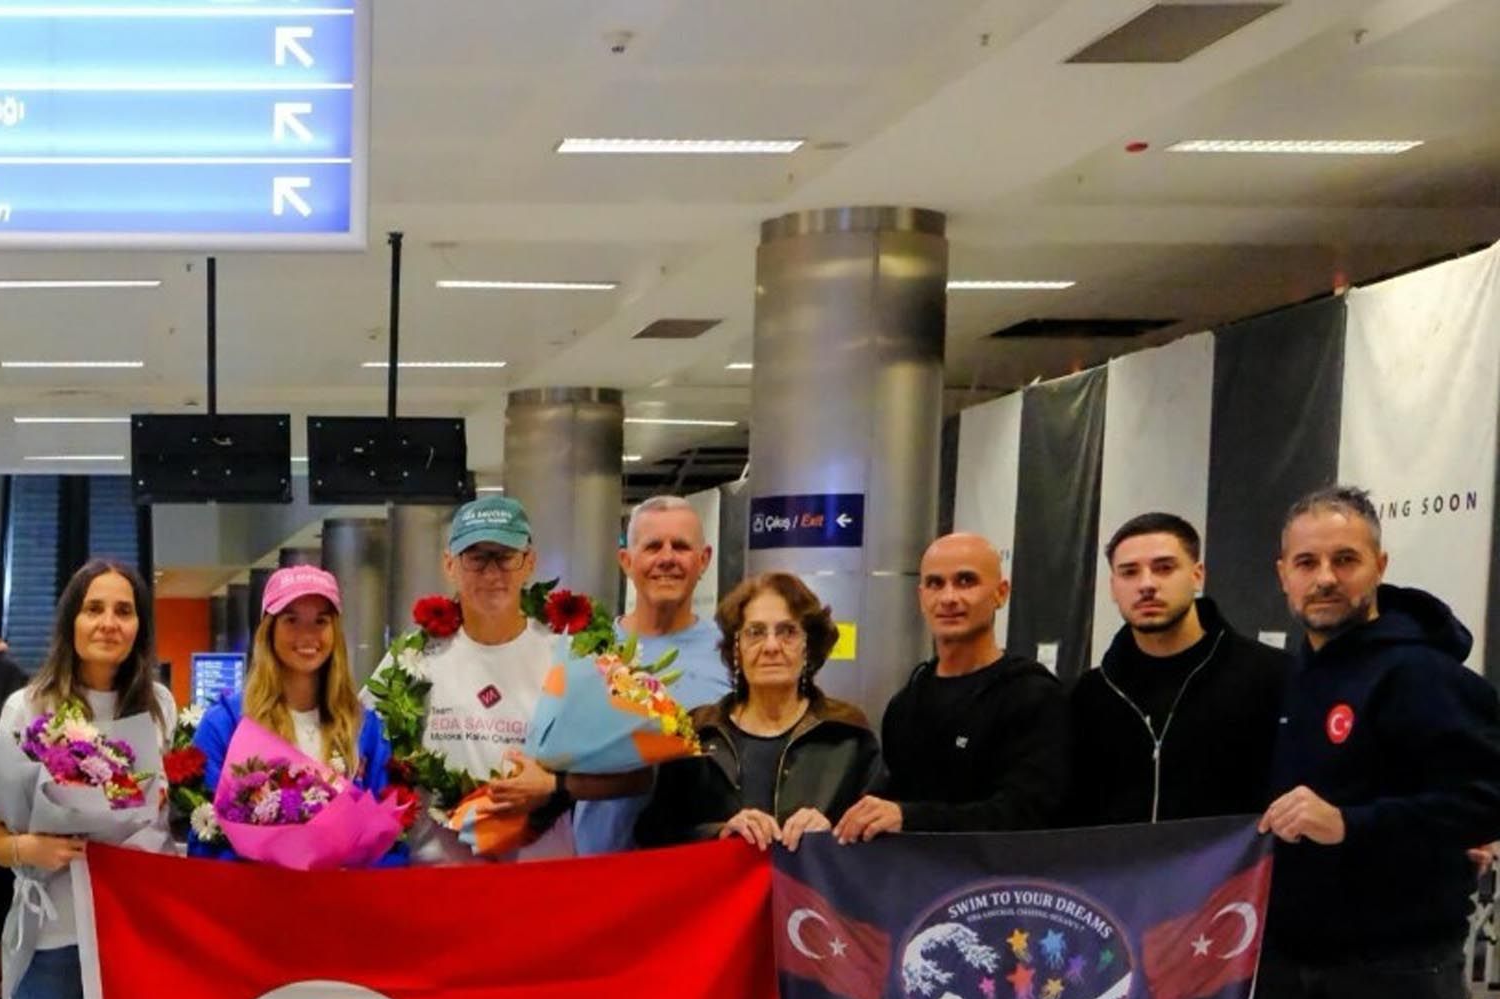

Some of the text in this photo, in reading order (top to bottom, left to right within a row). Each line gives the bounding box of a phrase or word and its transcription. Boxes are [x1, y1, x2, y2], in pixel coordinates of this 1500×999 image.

[1380, 491, 1477, 519] ING SOON
[948, 893, 988, 919] SWIM
[990, 891, 1011, 906] TO
[1012, 890, 1054, 908] YOUR
[1055, 897, 1114, 939] DREAMS
